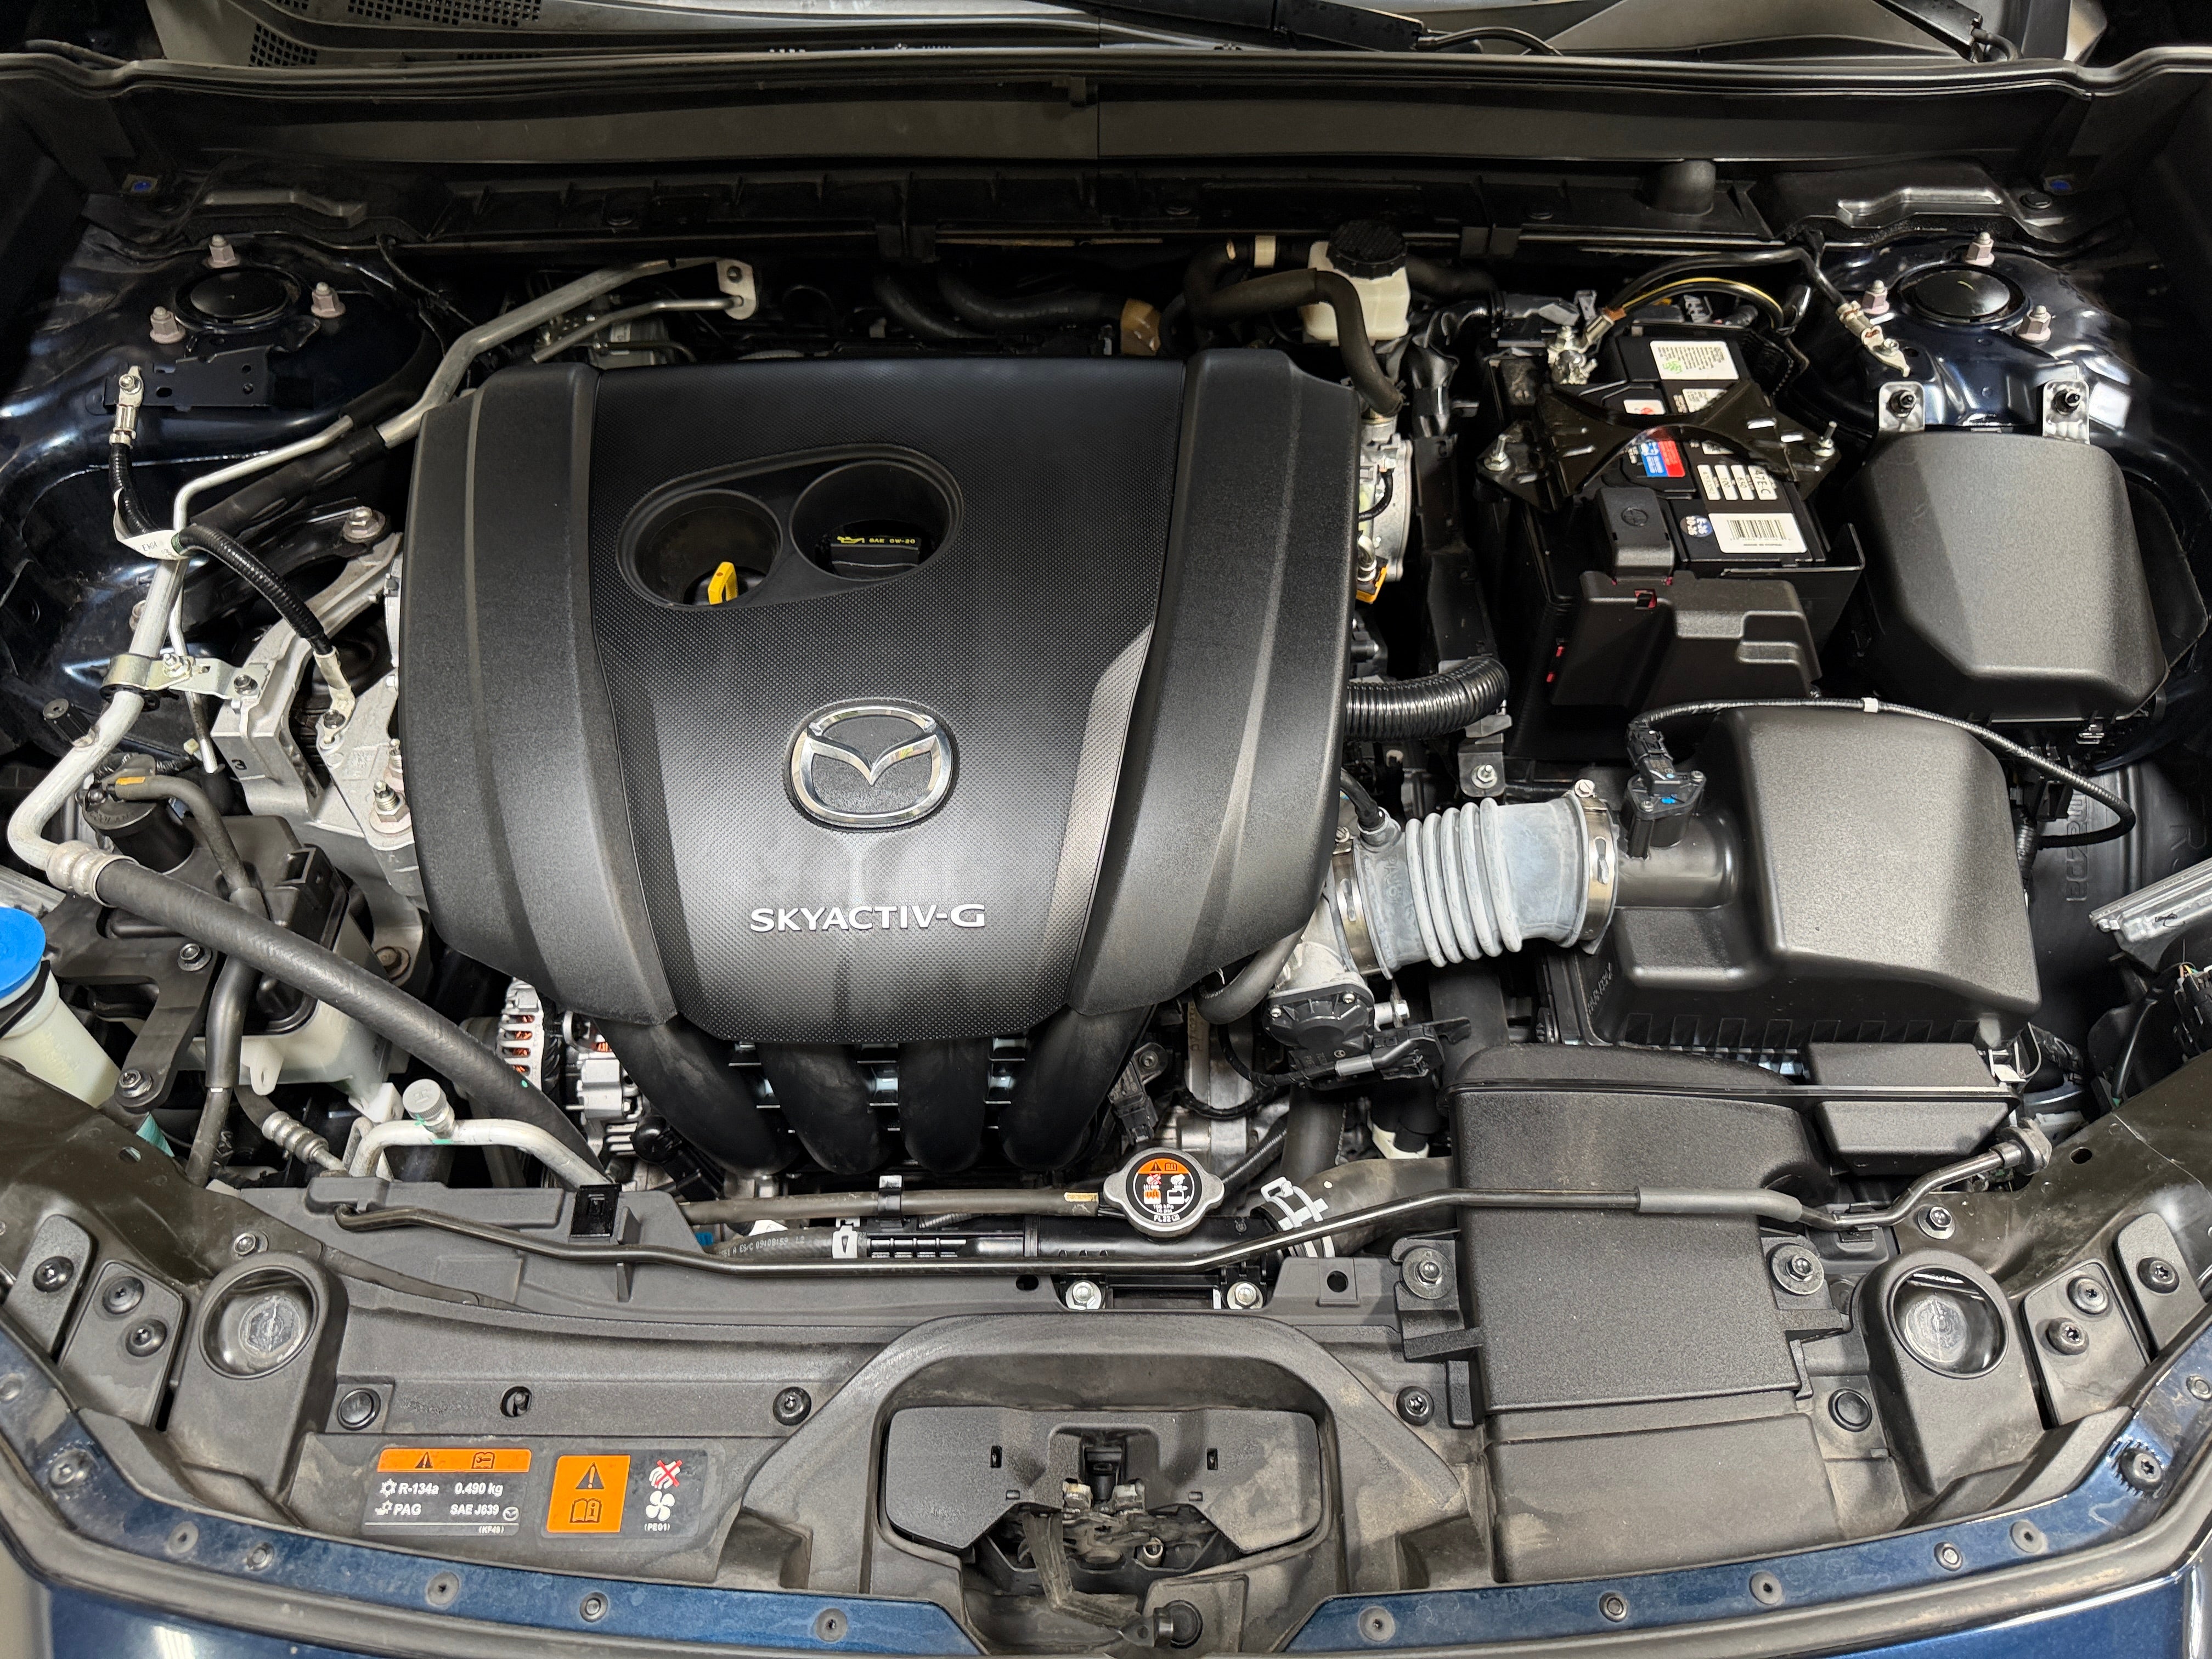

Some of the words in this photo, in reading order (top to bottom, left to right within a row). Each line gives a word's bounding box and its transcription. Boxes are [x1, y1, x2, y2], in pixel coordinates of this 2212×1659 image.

[749, 903, 986, 933] SKYACTIV-G
[1154, 1214, 1171, 1222] FL22
[398, 1482, 439, 1494] R-134a
[454, 1482, 487, 1494] 0.490
[487, 1482, 504, 1497] kg
[393, 1503, 422, 1516] PAG
[450, 1504, 473, 1515] SAE
[474, 1504, 500, 1515] J639
[644, 1522, 670, 1531] (PE01)
